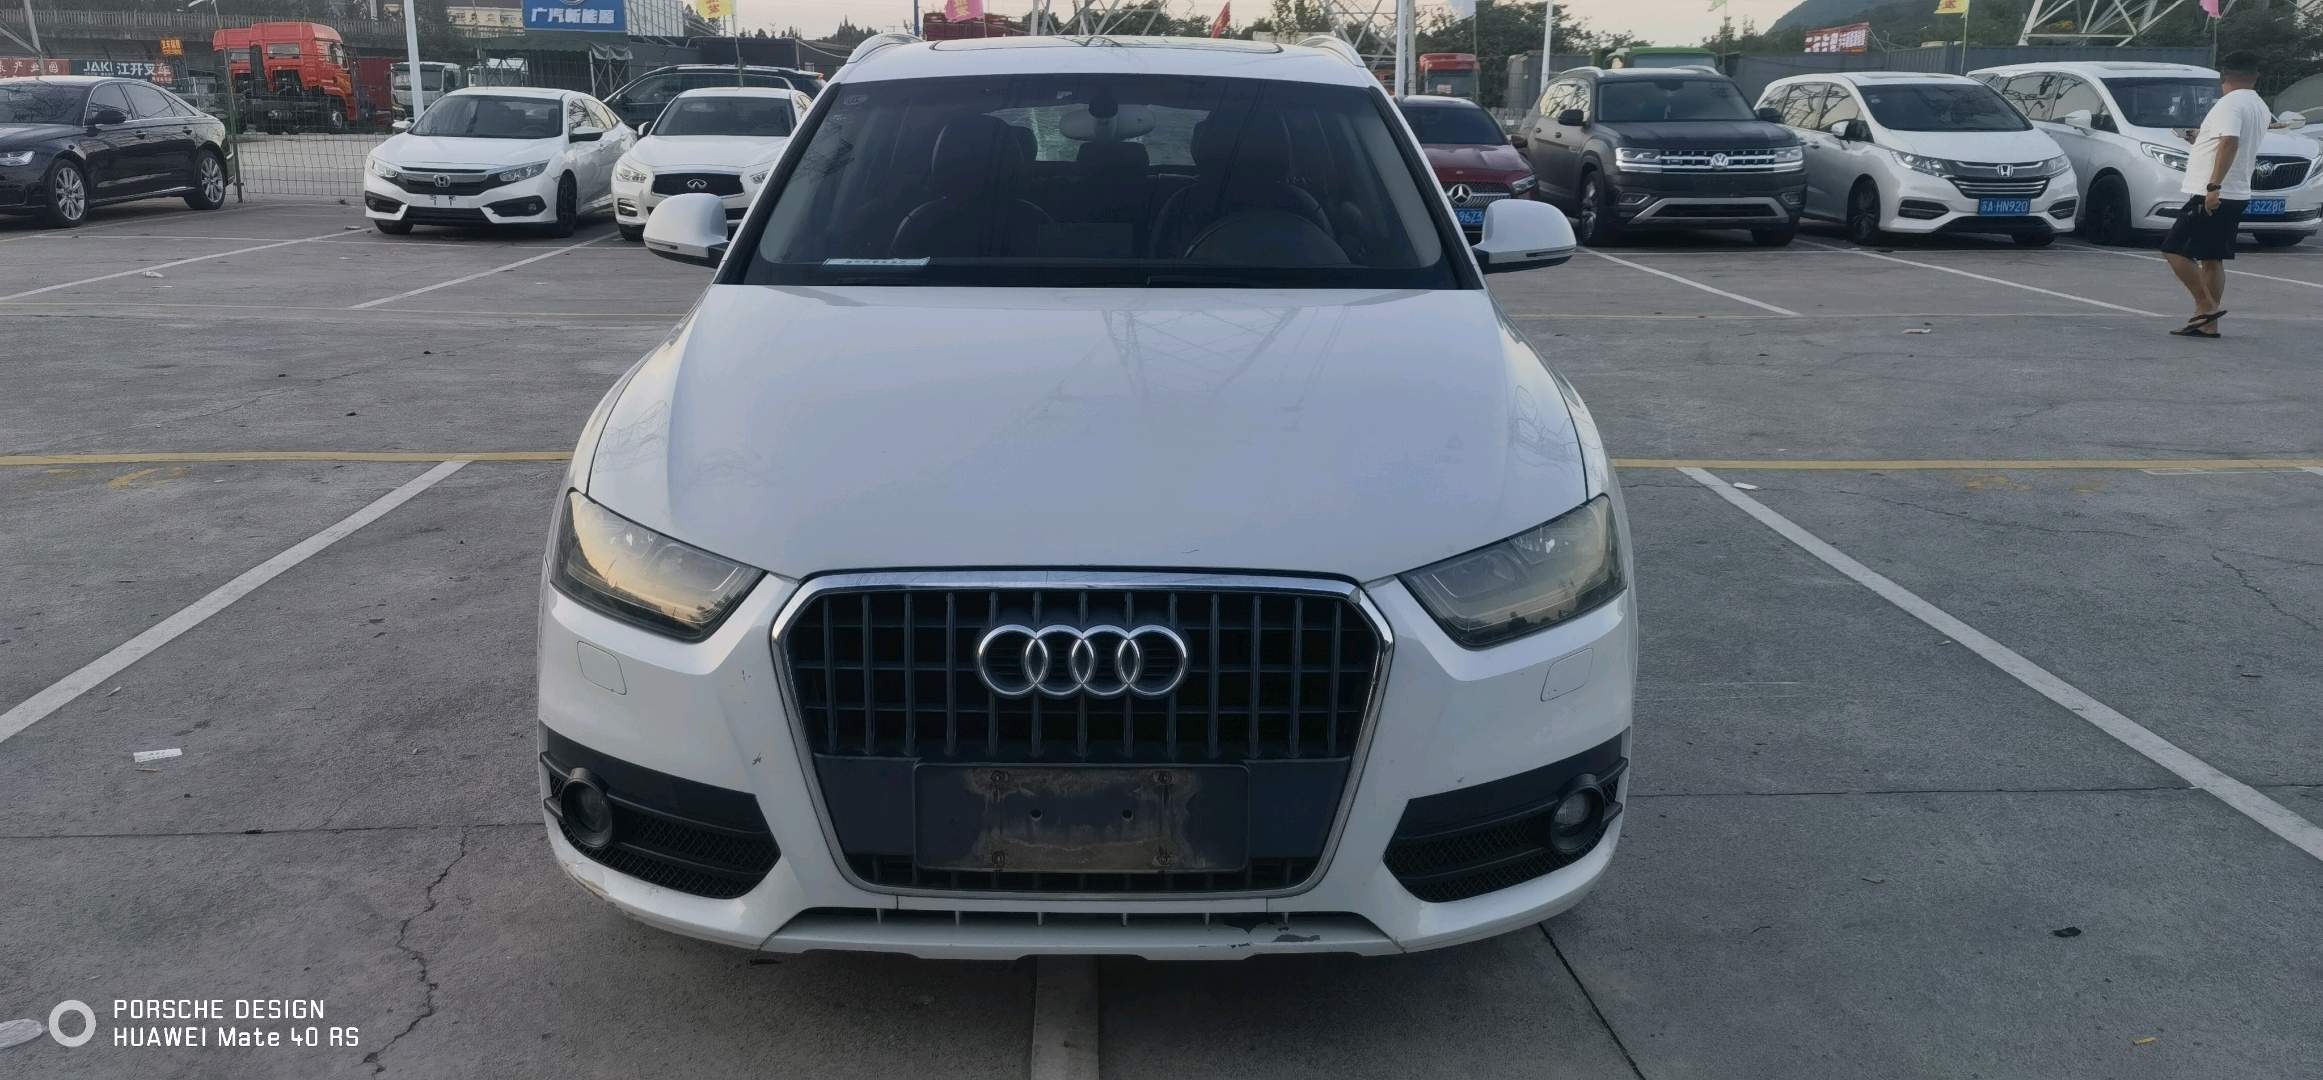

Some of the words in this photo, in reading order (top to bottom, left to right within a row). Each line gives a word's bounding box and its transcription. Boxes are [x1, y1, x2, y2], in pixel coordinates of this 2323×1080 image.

[531, 7, 614, 24] 广汽新能源
